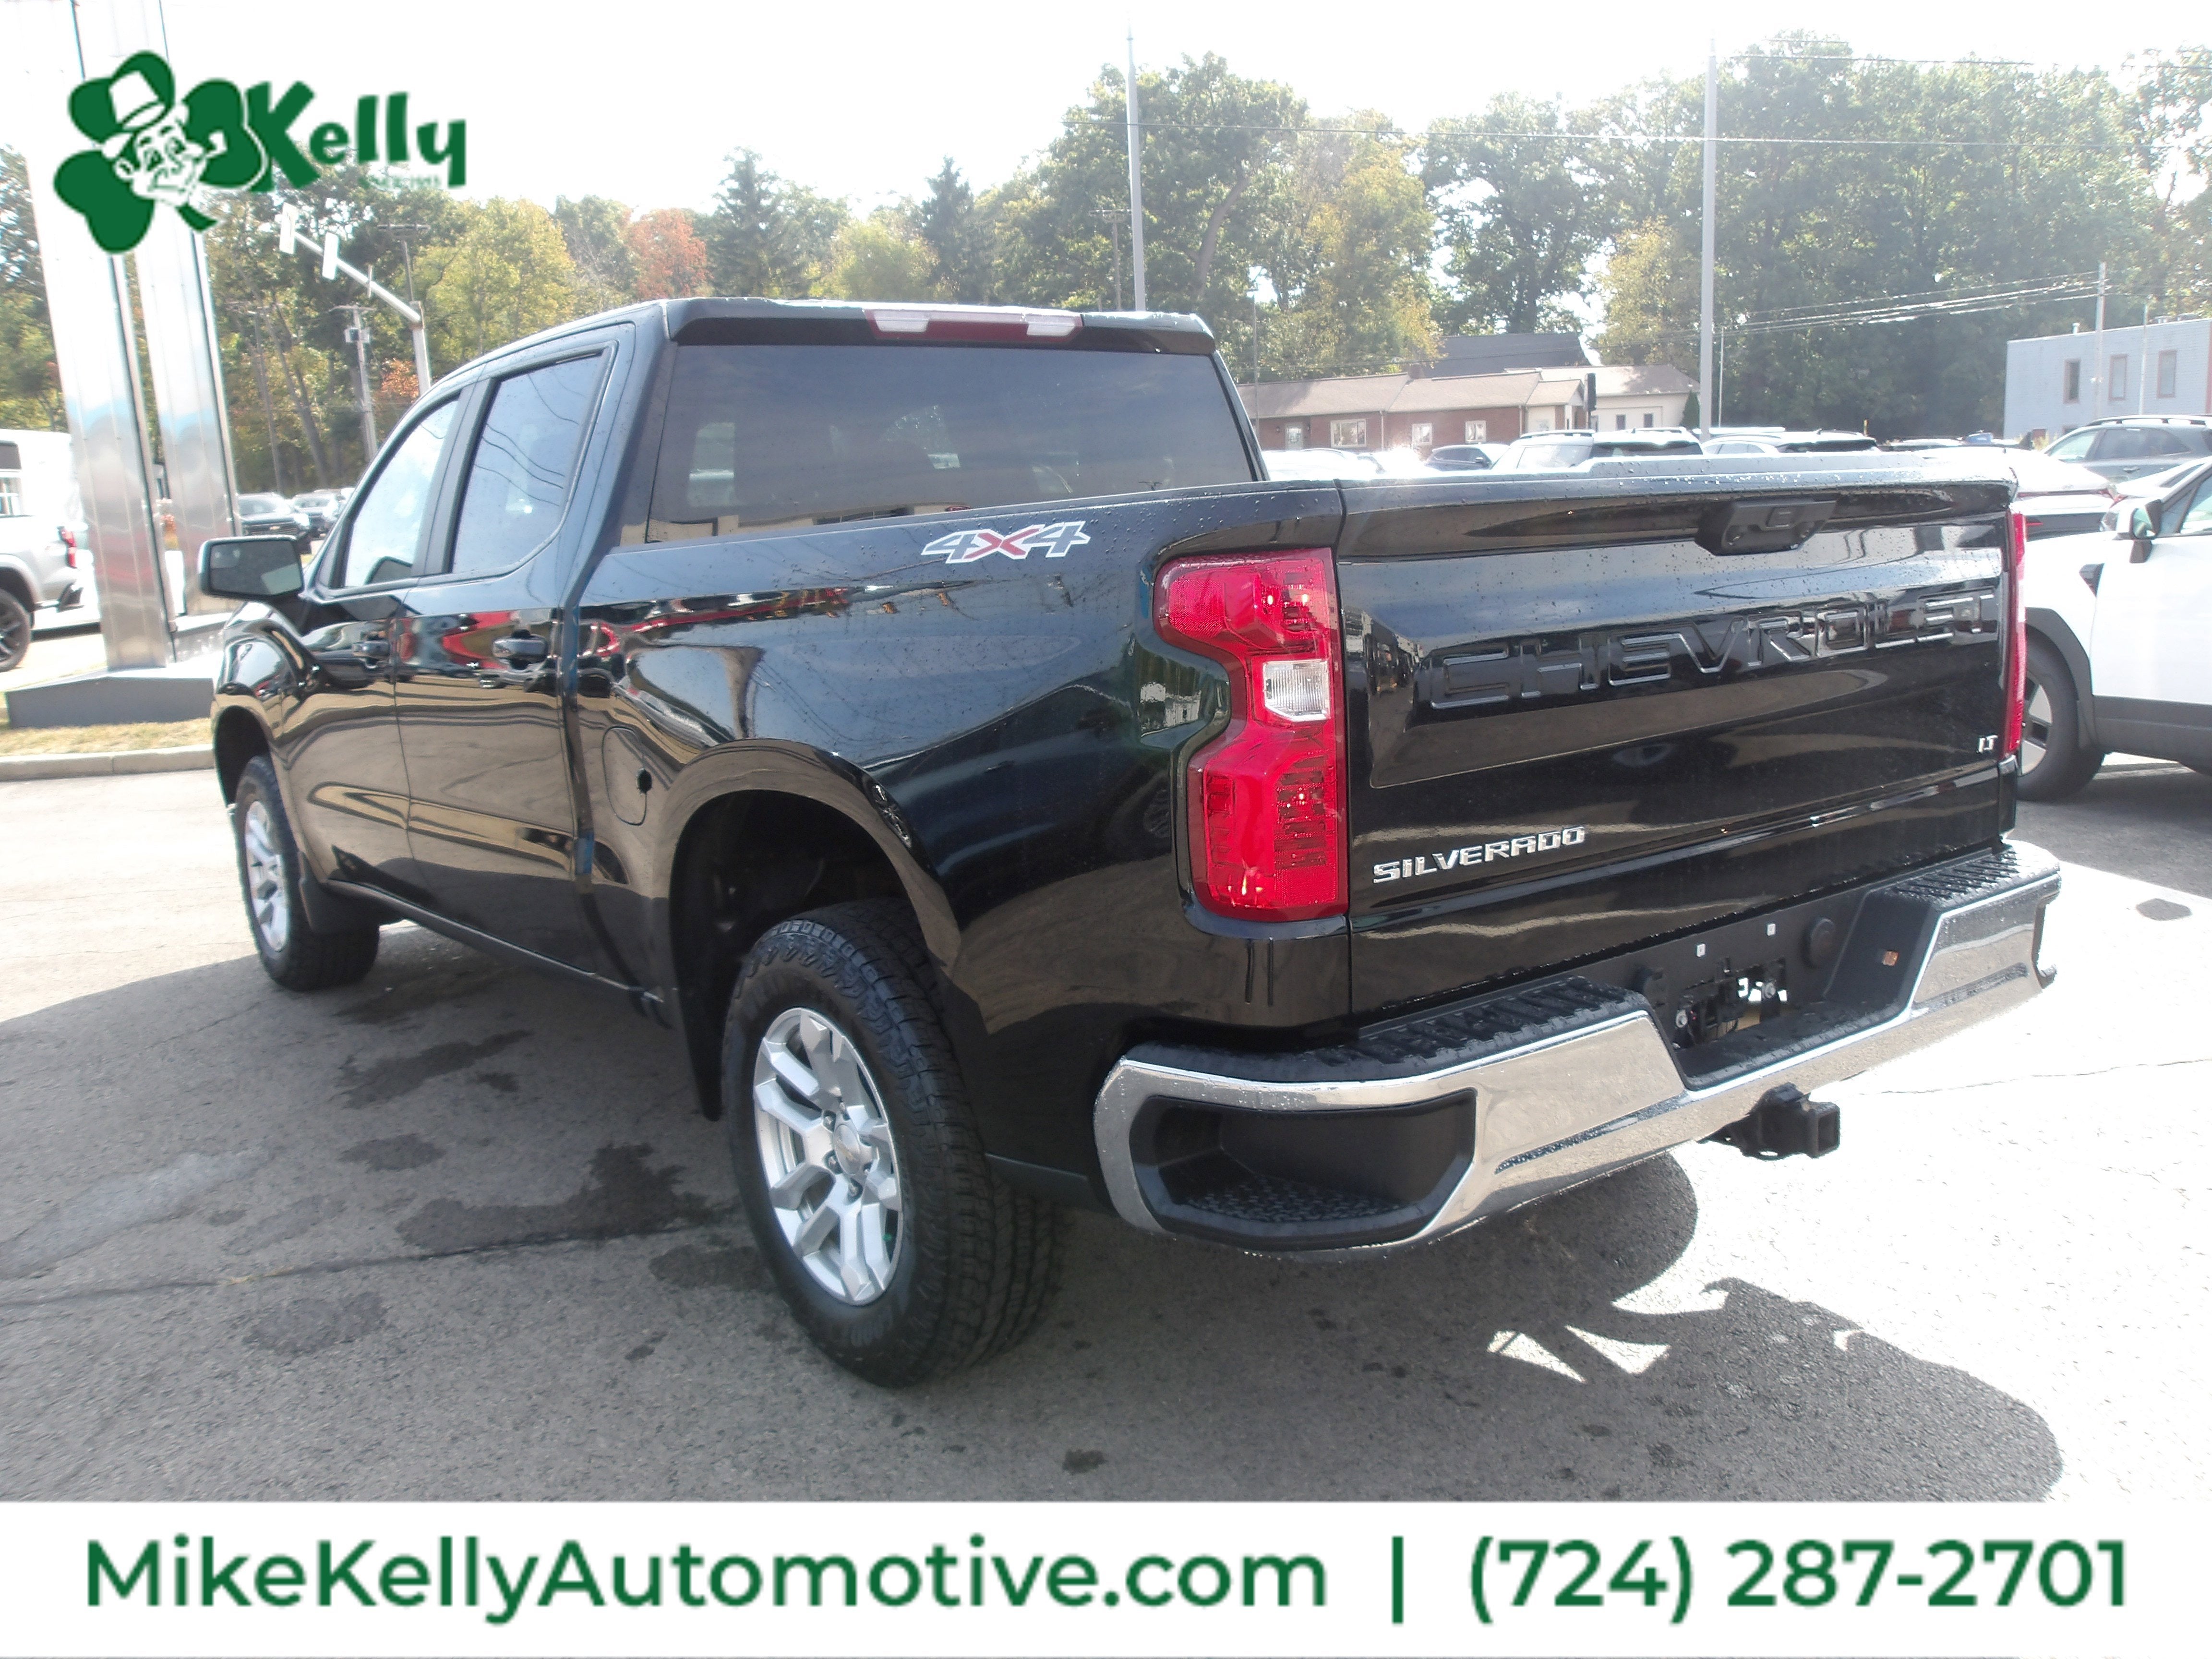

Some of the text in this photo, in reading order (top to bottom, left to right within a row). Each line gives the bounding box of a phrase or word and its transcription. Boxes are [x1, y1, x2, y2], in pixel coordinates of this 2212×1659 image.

[1430, 586, 1997, 710] CHEVROLET
[1978, 734, 1998, 753] LT
[1373, 826, 1586, 884] SILVERADO
